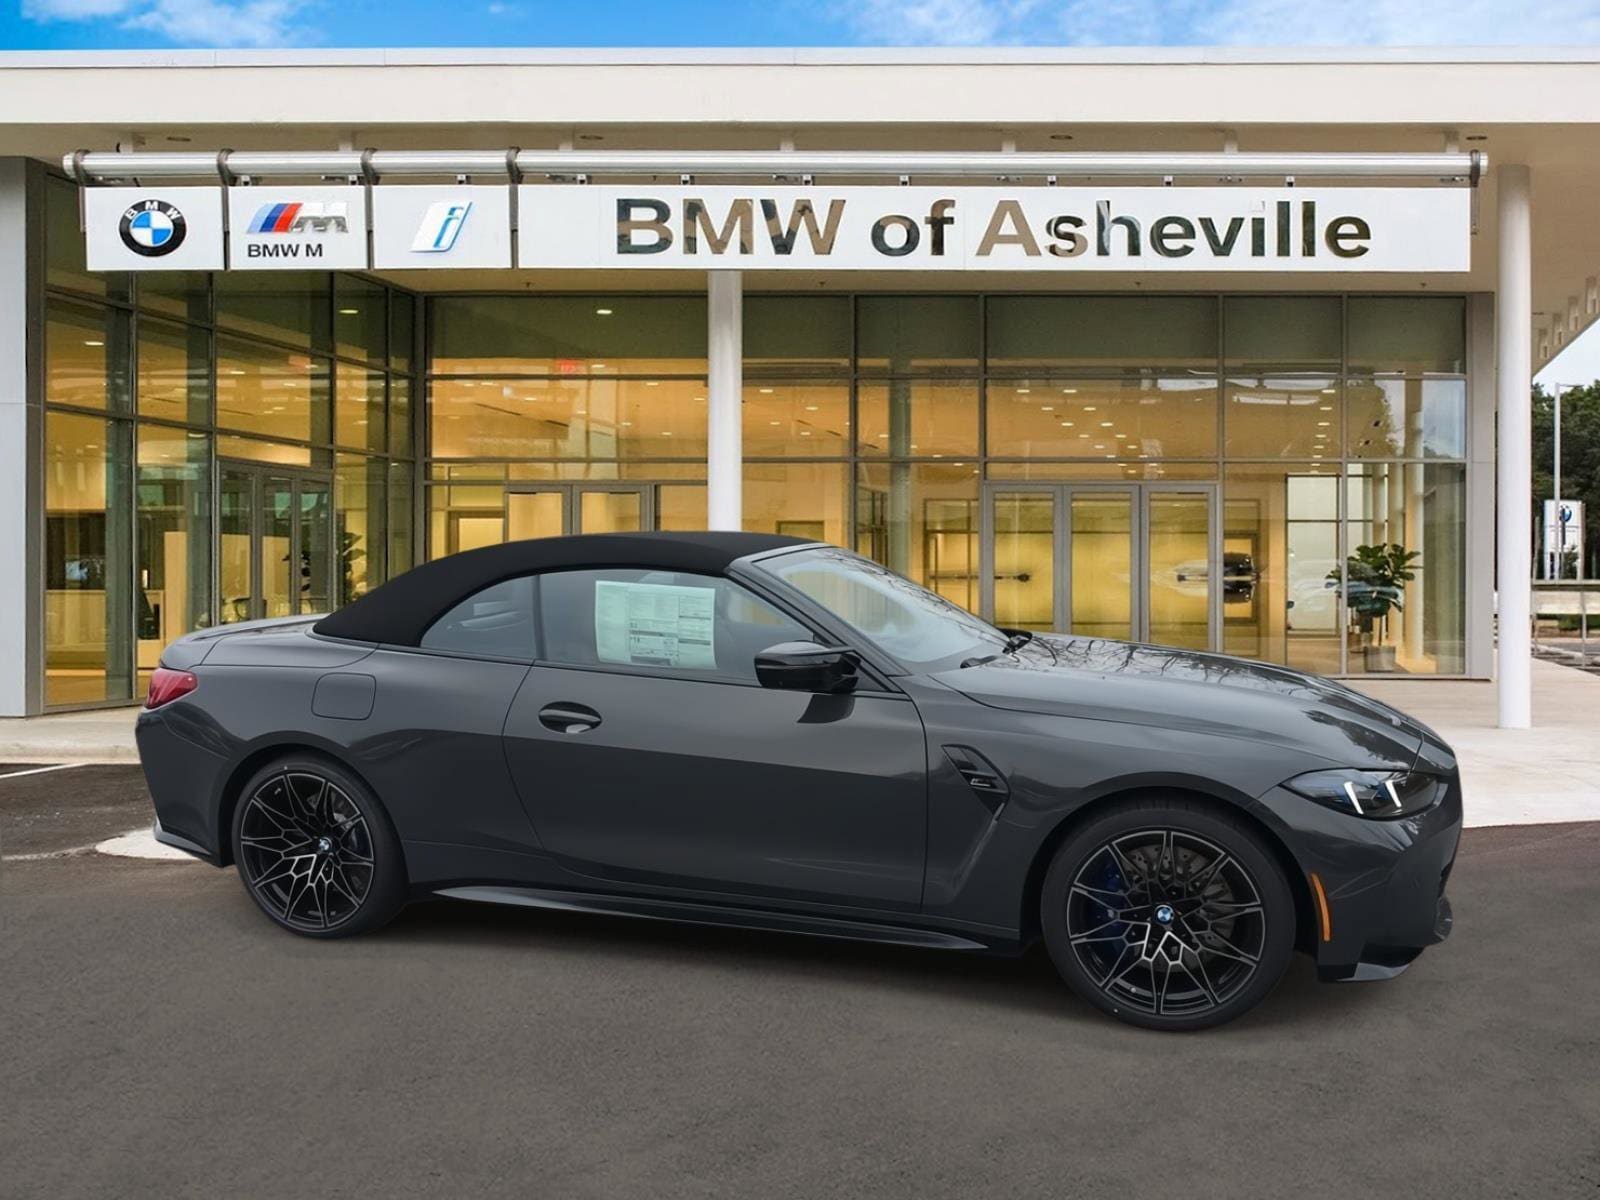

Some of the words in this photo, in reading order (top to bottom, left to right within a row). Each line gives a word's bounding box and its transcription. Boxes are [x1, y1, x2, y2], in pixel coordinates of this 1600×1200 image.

[124, 200, 181, 220] BMW
[616, 198, 846, 256] BMW
[870, 199, 956, 258] of
[975, 199, 1372, 258] Asheville
[247, 243, 300, 258] BMW
[305, 243, 323, 258] M
